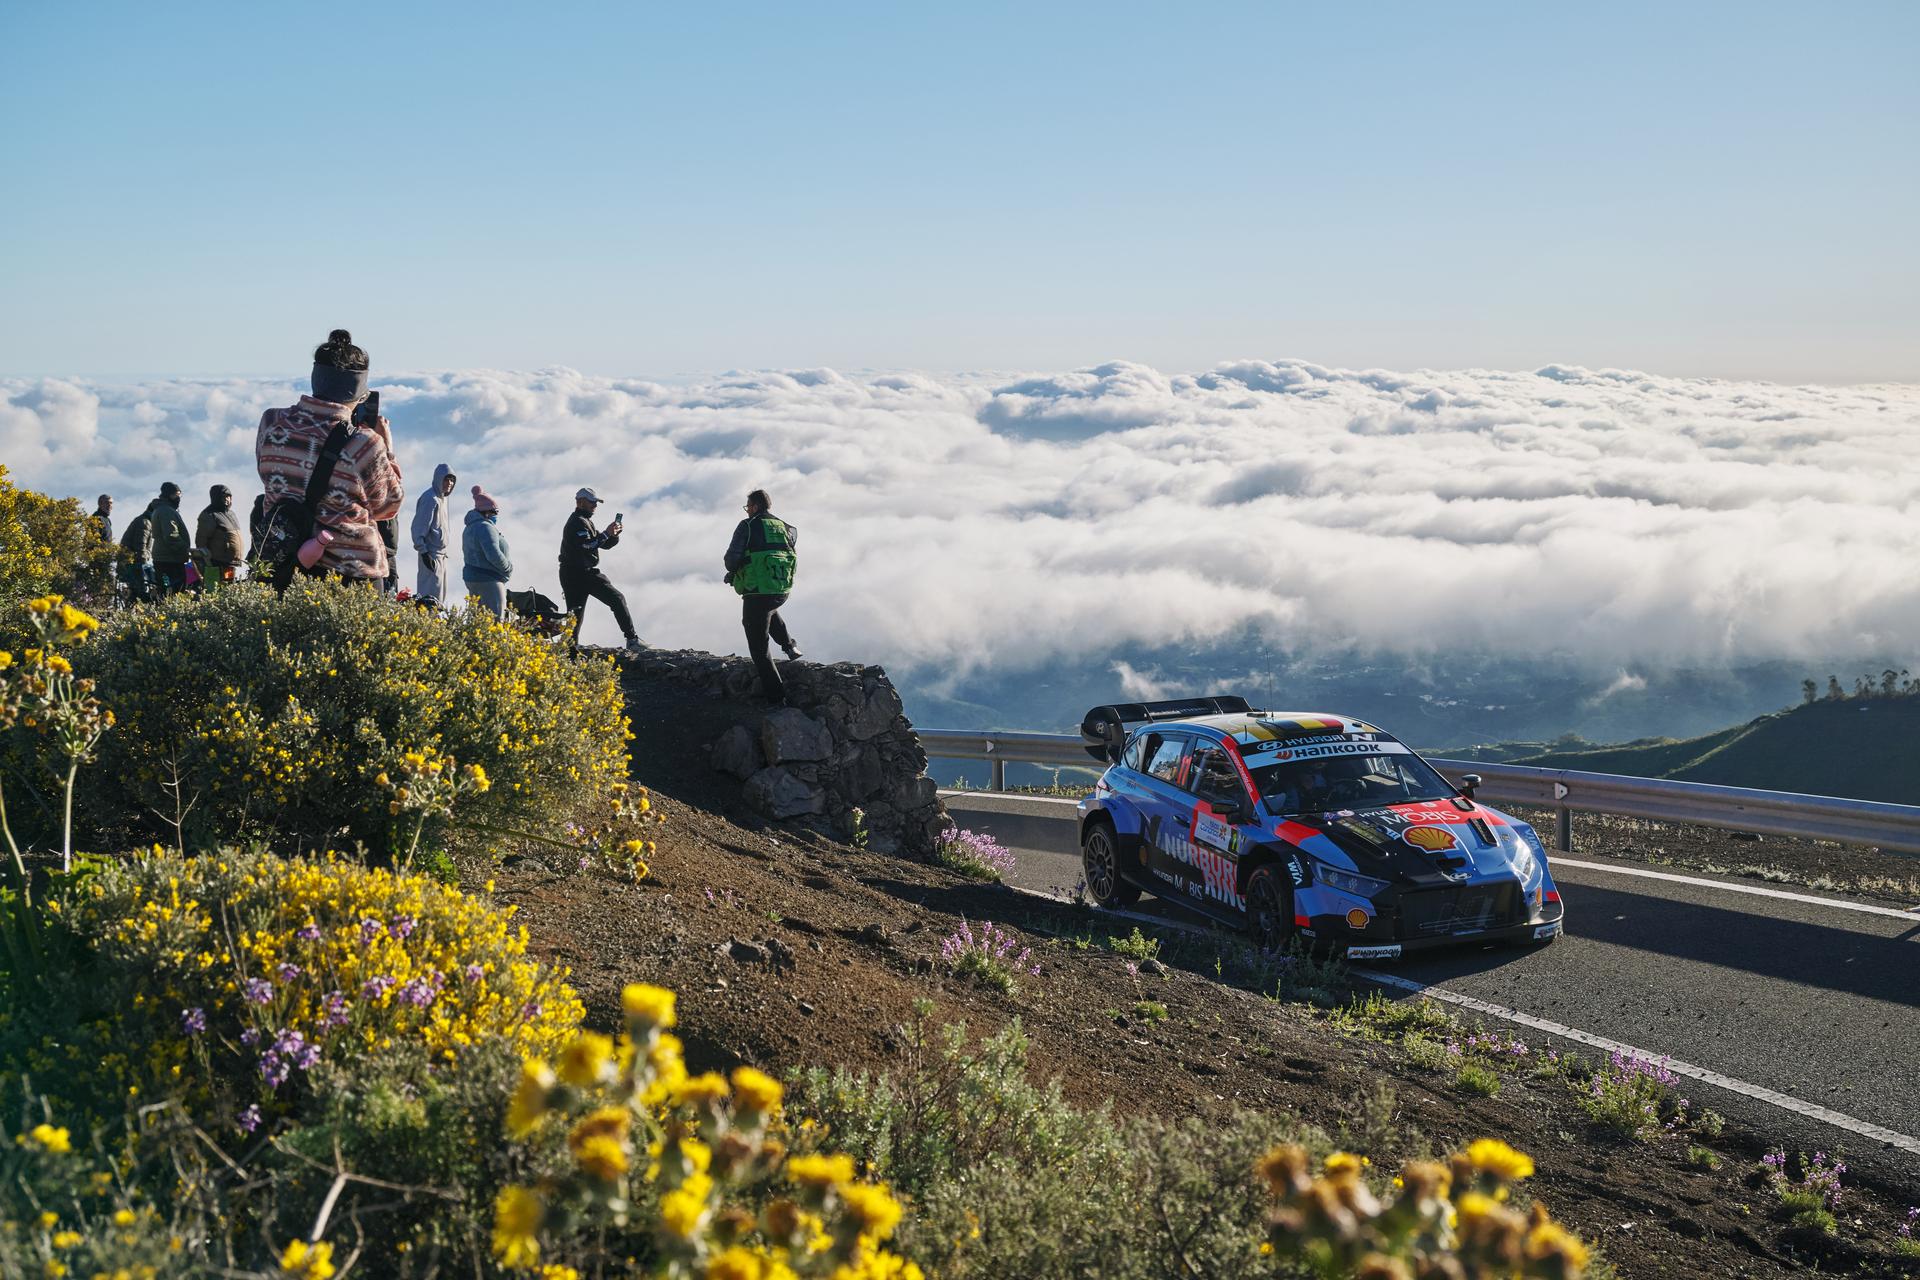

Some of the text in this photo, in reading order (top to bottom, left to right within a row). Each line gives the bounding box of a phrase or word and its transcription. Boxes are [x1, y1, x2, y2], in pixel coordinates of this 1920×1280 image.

[1285, 734, 1346, 746] HYUNDAI
[1176, 755, 1193, 786] 11
[1358, 807, 1414, 818] HYUNDAI
[1381, 810, 1460, 825] MOBIS
[1165, 833, 1238, 882] NÜRBUR
[1174, 874, 1203, 900] MBIS
